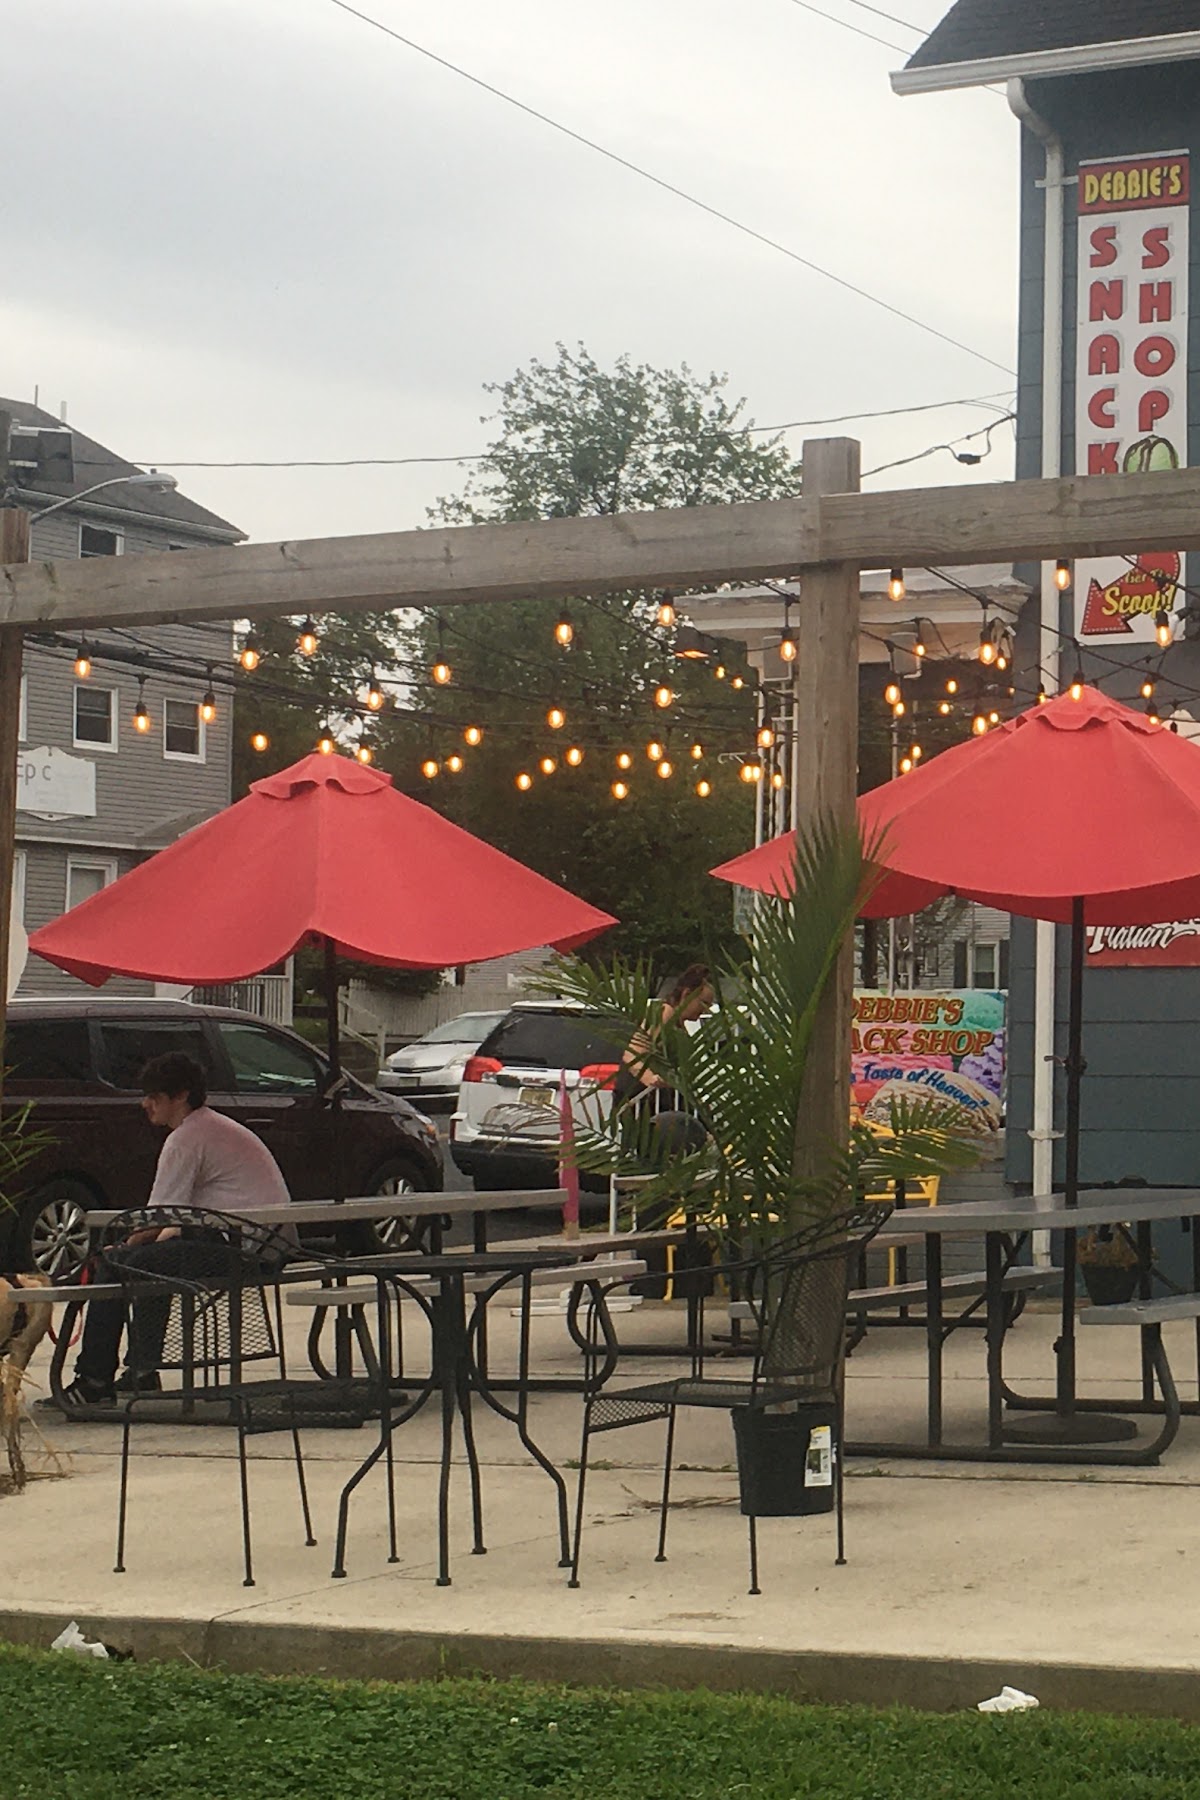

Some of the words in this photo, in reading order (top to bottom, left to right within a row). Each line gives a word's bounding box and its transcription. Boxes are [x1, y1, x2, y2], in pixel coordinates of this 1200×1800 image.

[1084, 164, 1182, 205] DEBBIE'S
[1087, 224, 1126, 475] SNACK
[1133, 226, 1177, 433] SHOP
[910, 1029, 995, 1056] SHOP
[863, 1062, 904, 1081] Taste
[906, 1067, 928, 1082] of
